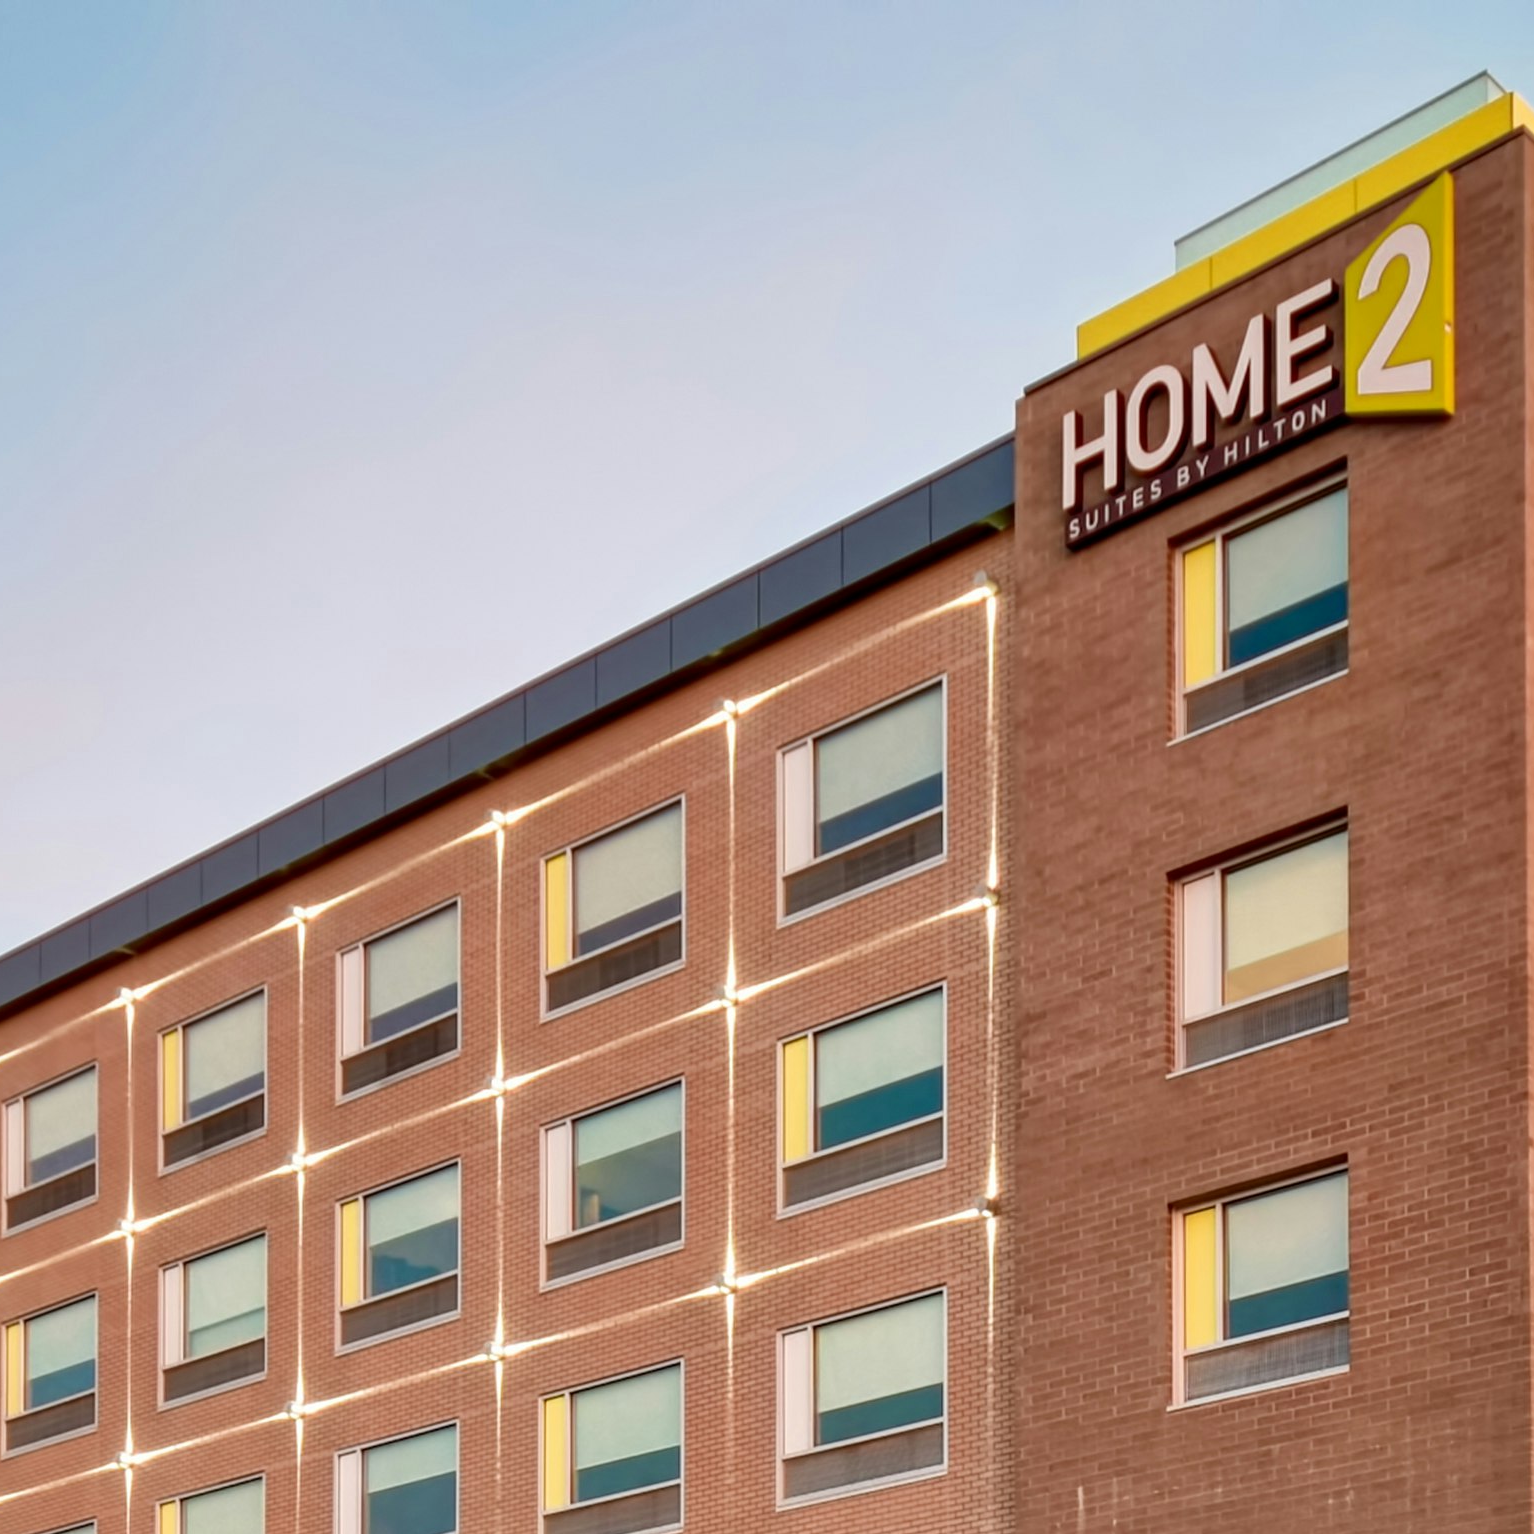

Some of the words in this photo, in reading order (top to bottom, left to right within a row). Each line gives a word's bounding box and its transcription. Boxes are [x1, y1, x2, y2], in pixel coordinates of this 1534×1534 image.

[1063, 278, 1333, 510] HOME
[1357, 223, 1432, 395] 2
[1069, 479, 1162, 539] SUITES
[1177, 455, 1209, 490] BY
[1224, 399, 1327, 465] HILTON
